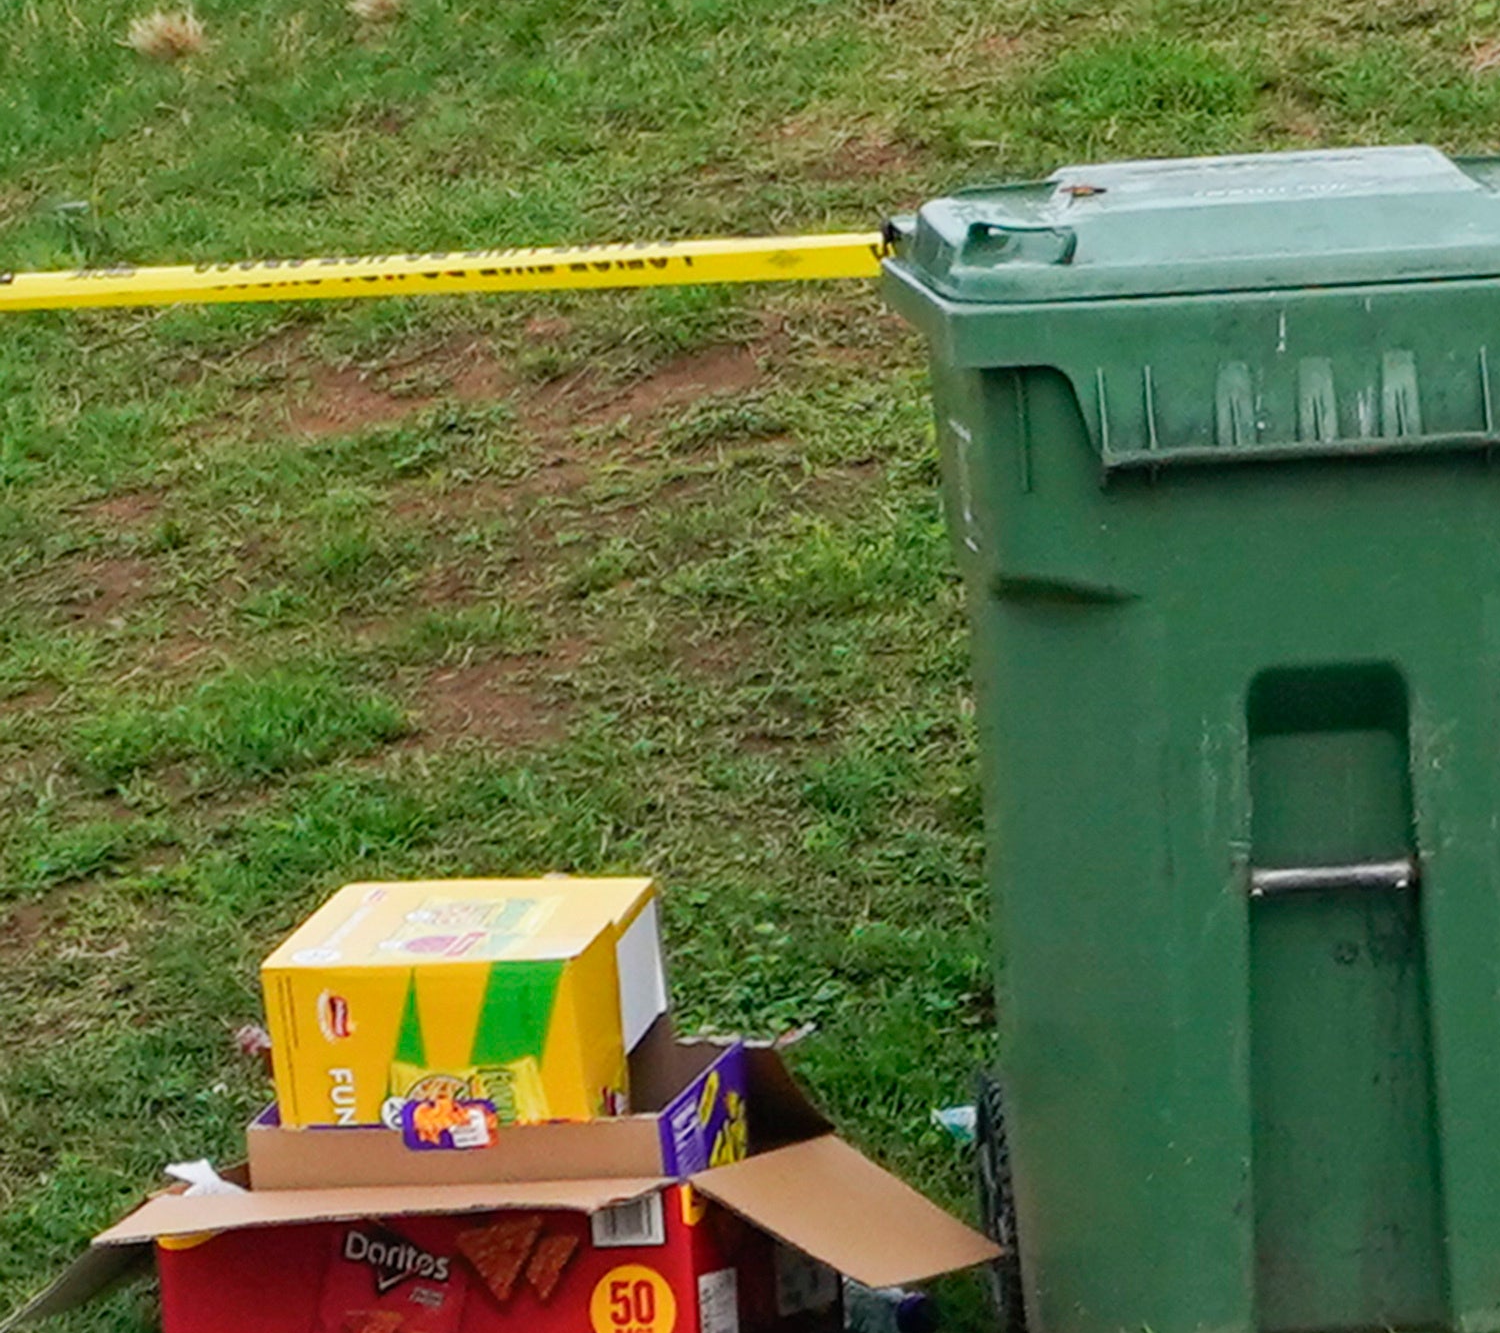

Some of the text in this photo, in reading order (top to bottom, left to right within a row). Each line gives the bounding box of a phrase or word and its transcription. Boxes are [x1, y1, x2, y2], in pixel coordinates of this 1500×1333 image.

[328, 1068, 359, 1126] FUN
[344, 1230, 452, 1282] Doritos
[608, 1279, 656, 1325] 50
